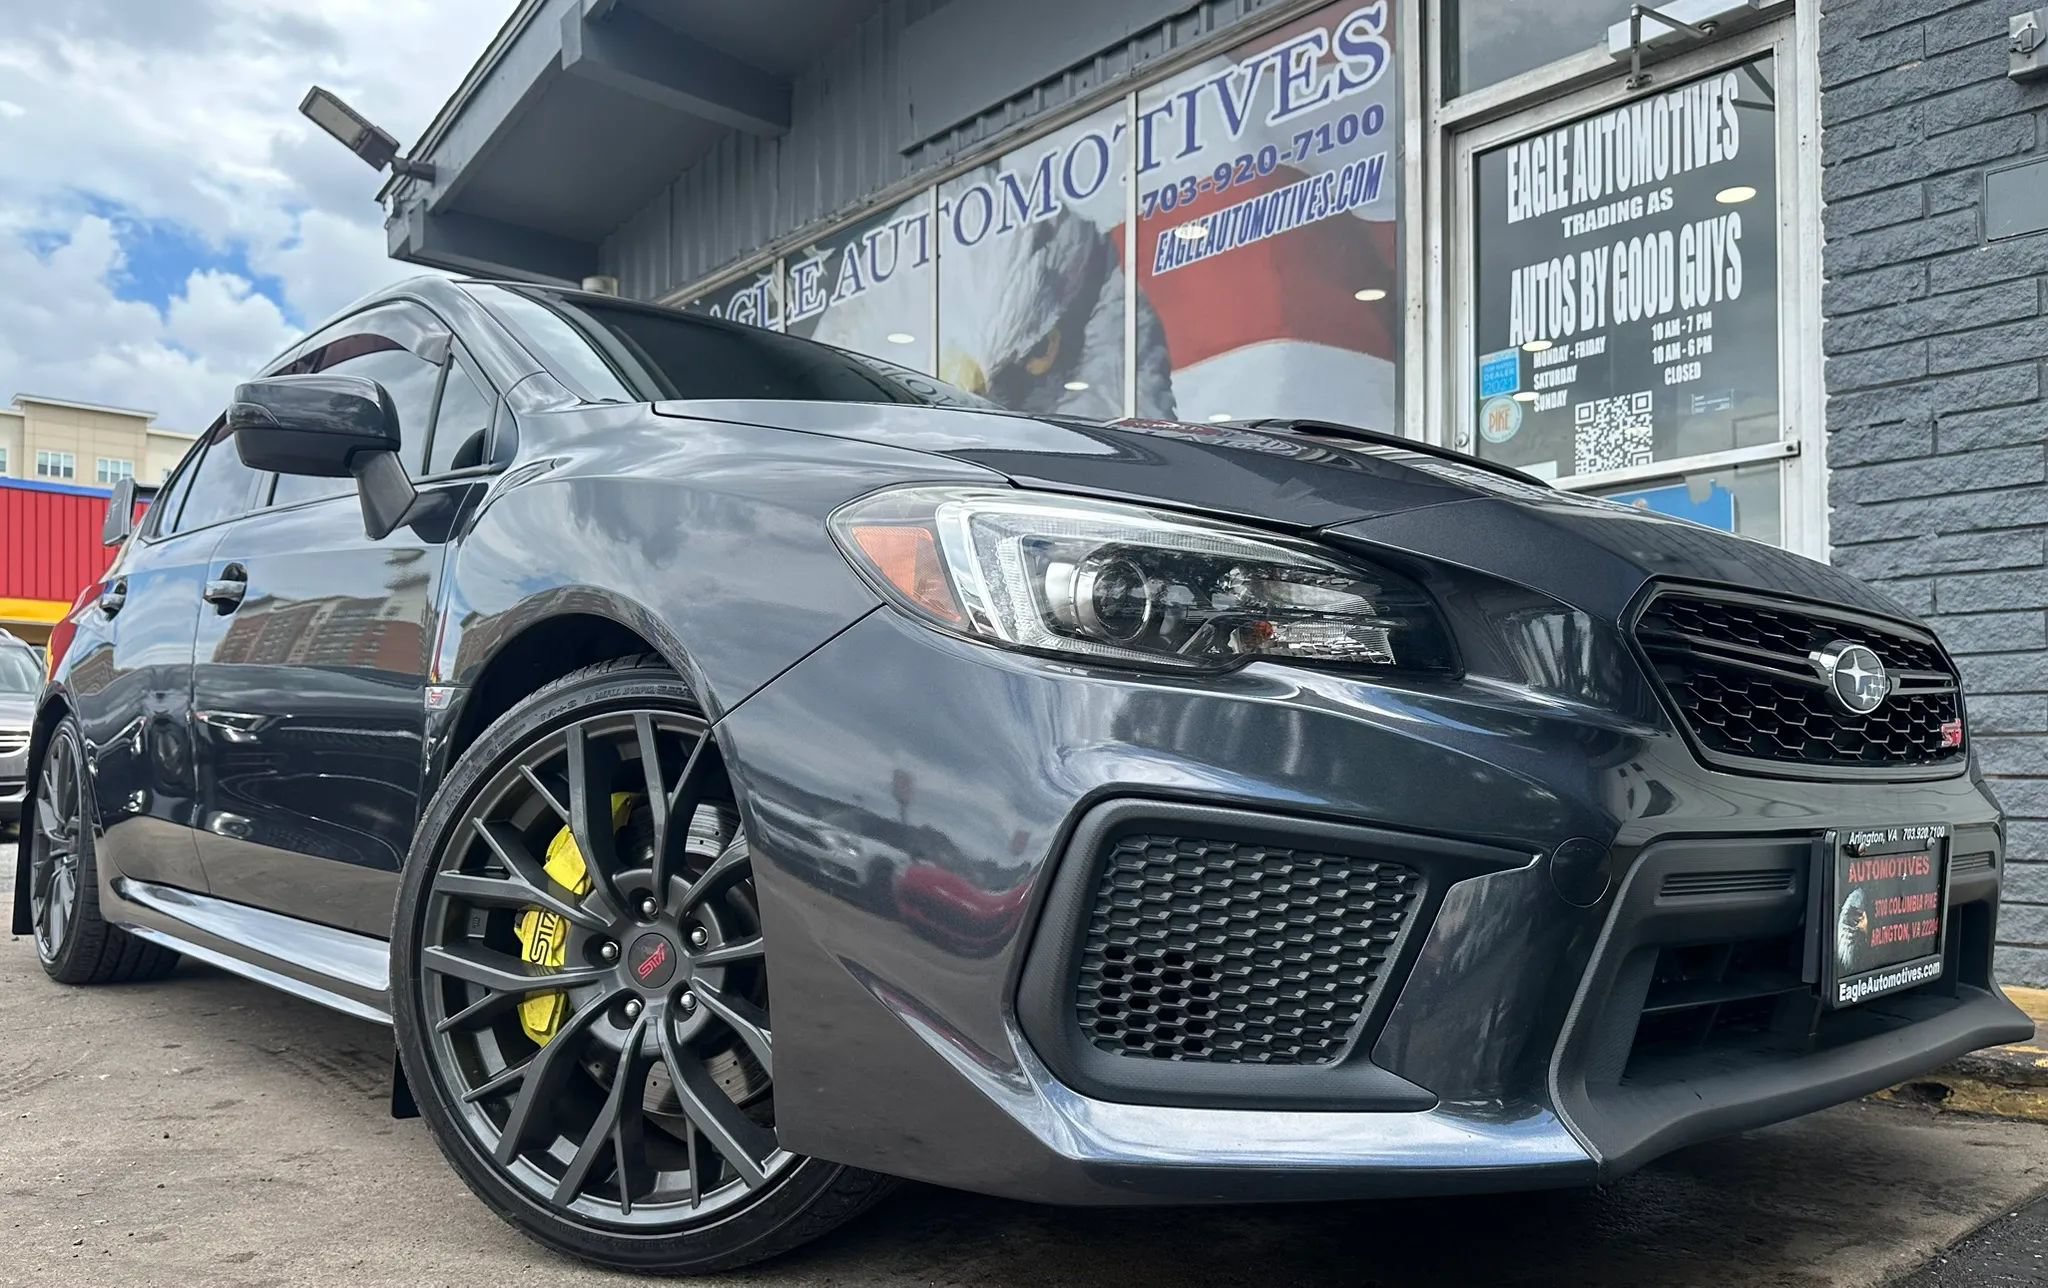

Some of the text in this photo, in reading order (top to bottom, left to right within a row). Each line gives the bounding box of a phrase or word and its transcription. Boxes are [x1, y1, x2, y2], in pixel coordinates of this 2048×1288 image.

[1142, 104, 1385, 220] 703-920-7100
[1507, 72, 1739, 224] EAGLE AUTOMOTIVES
[709, 0, 1391, 331] GLE AUTOMOTIVES
[1561, 187, 1673, 238] TRADING AS
[1509, 211, 1742, 347] AUTOS BY GOOD GUYS
[1651, 322, 1664, 341] 10
[1664, 318, 1680, 338] AM
[1686, 315, 1693, 333] 7
[1696, 311, 1712, 331] PM
[1533, 344, 1569, 369] MONDAY
[1575, 336, 1606, 359] FRIDAY
[1652, 345, 1664, 364] 10
[1665, 341, 1681, 362] AM
[1687, 338, 1695, 357] 6
[1696, 335, 1712, 355] PM
[1533, 365, 1577, 390] SATURDAY
[1664, 361, 1701, 385] CLOSED
[1533, 389, 1568, 412] SUNDAY
[1488, 406, 1511, 432] PIKE
[1848, 831, 1885, 846] Arlington,
[1887, 829, 1897, 842] VA
[1848, 855, 1930, 883] AUTOMOTIVES
[1911, 921, 1921, 938] VA
[1839, 960, 1940, 1002] EagleAutomotives.com
